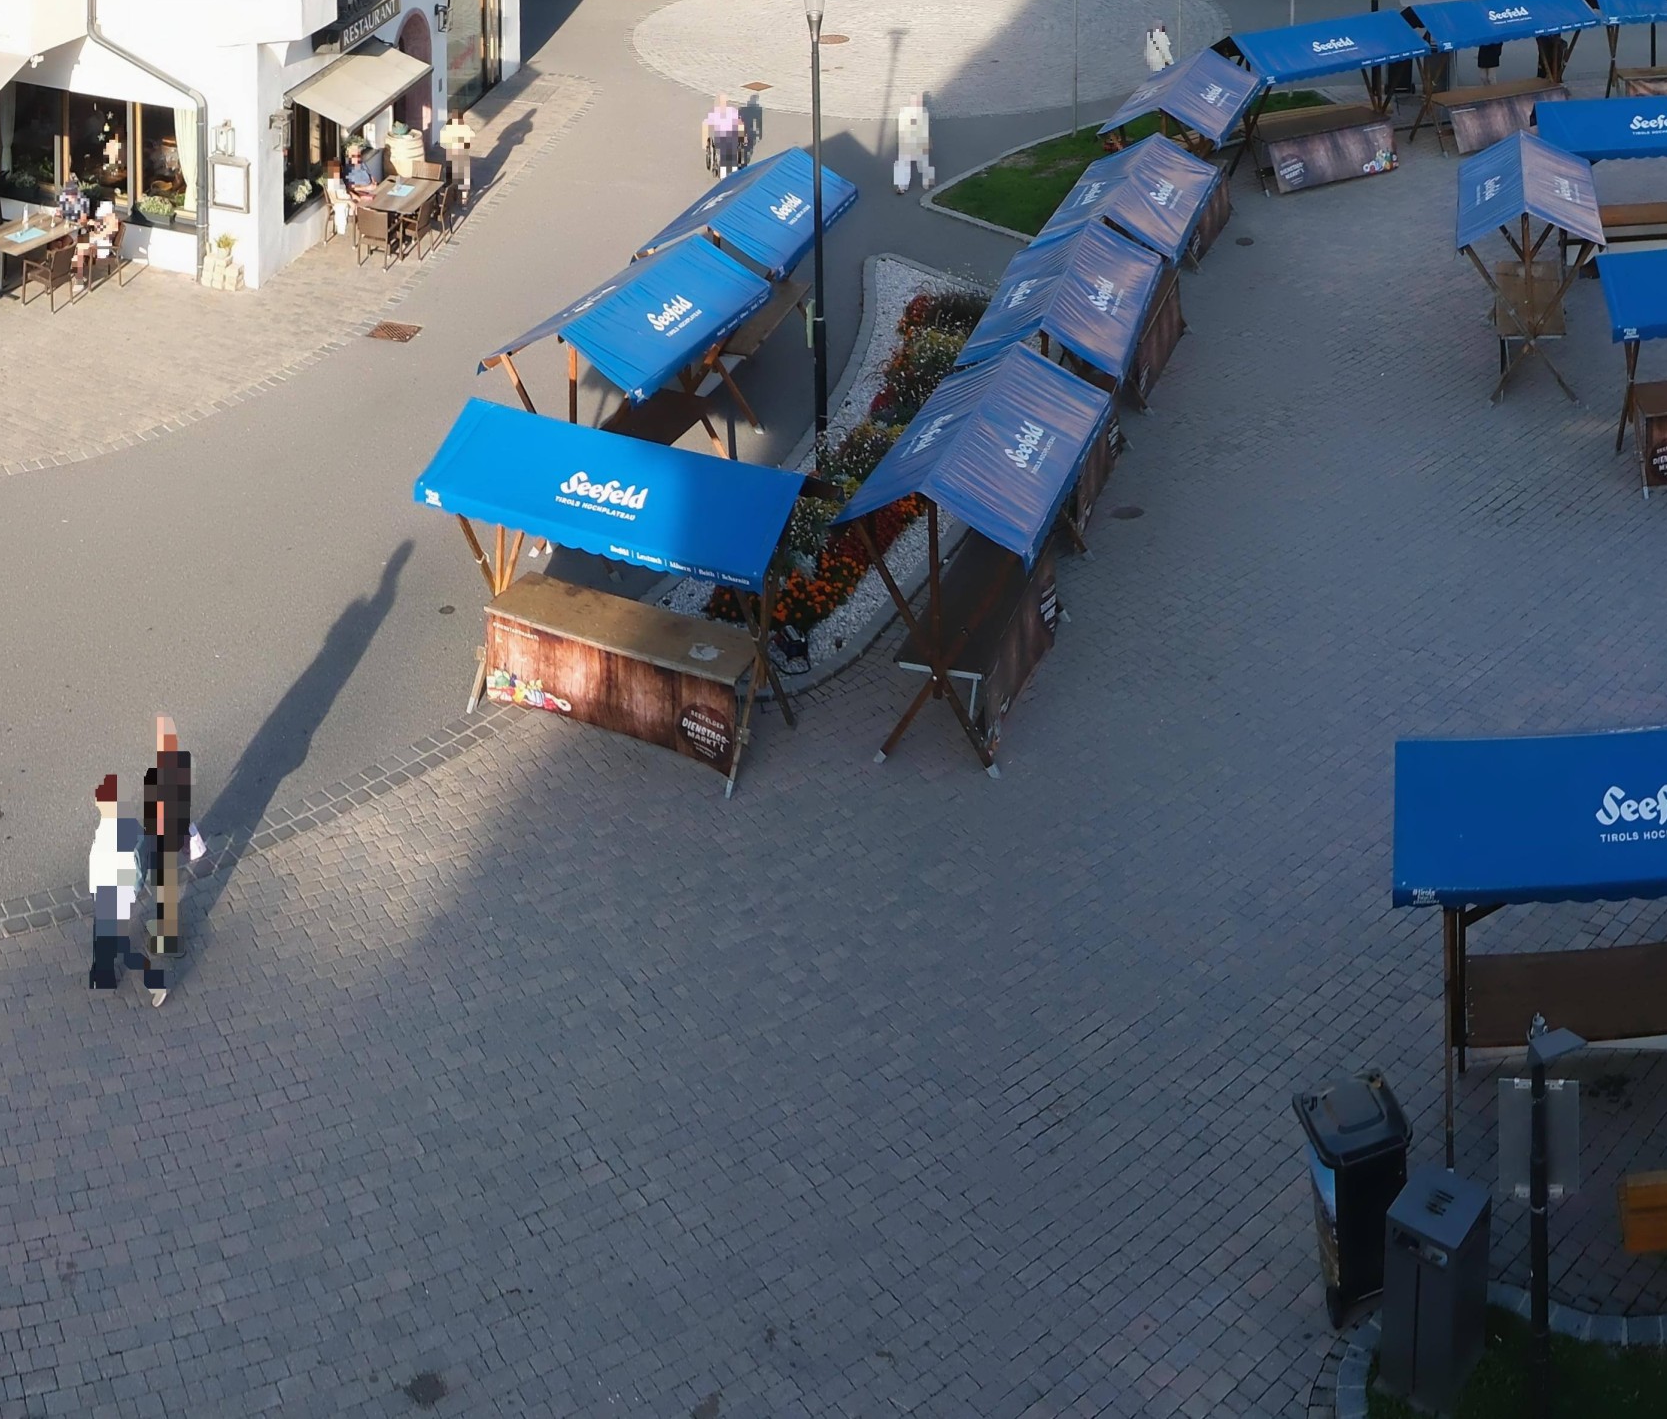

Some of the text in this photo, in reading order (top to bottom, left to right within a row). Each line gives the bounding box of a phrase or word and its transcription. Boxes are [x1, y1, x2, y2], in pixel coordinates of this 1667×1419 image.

[1489, 6, 1529, 21] Seefeld
[1312, 37, 1355, 52] Seefeld
[647, 294, 693, 332] Seefeld
[560, 471, 648, 509] Seefeld
[555, 495, 636, 521] TIROLS HOCHPLATEAU
[1600, 830, 1639, 843] TIROLS
